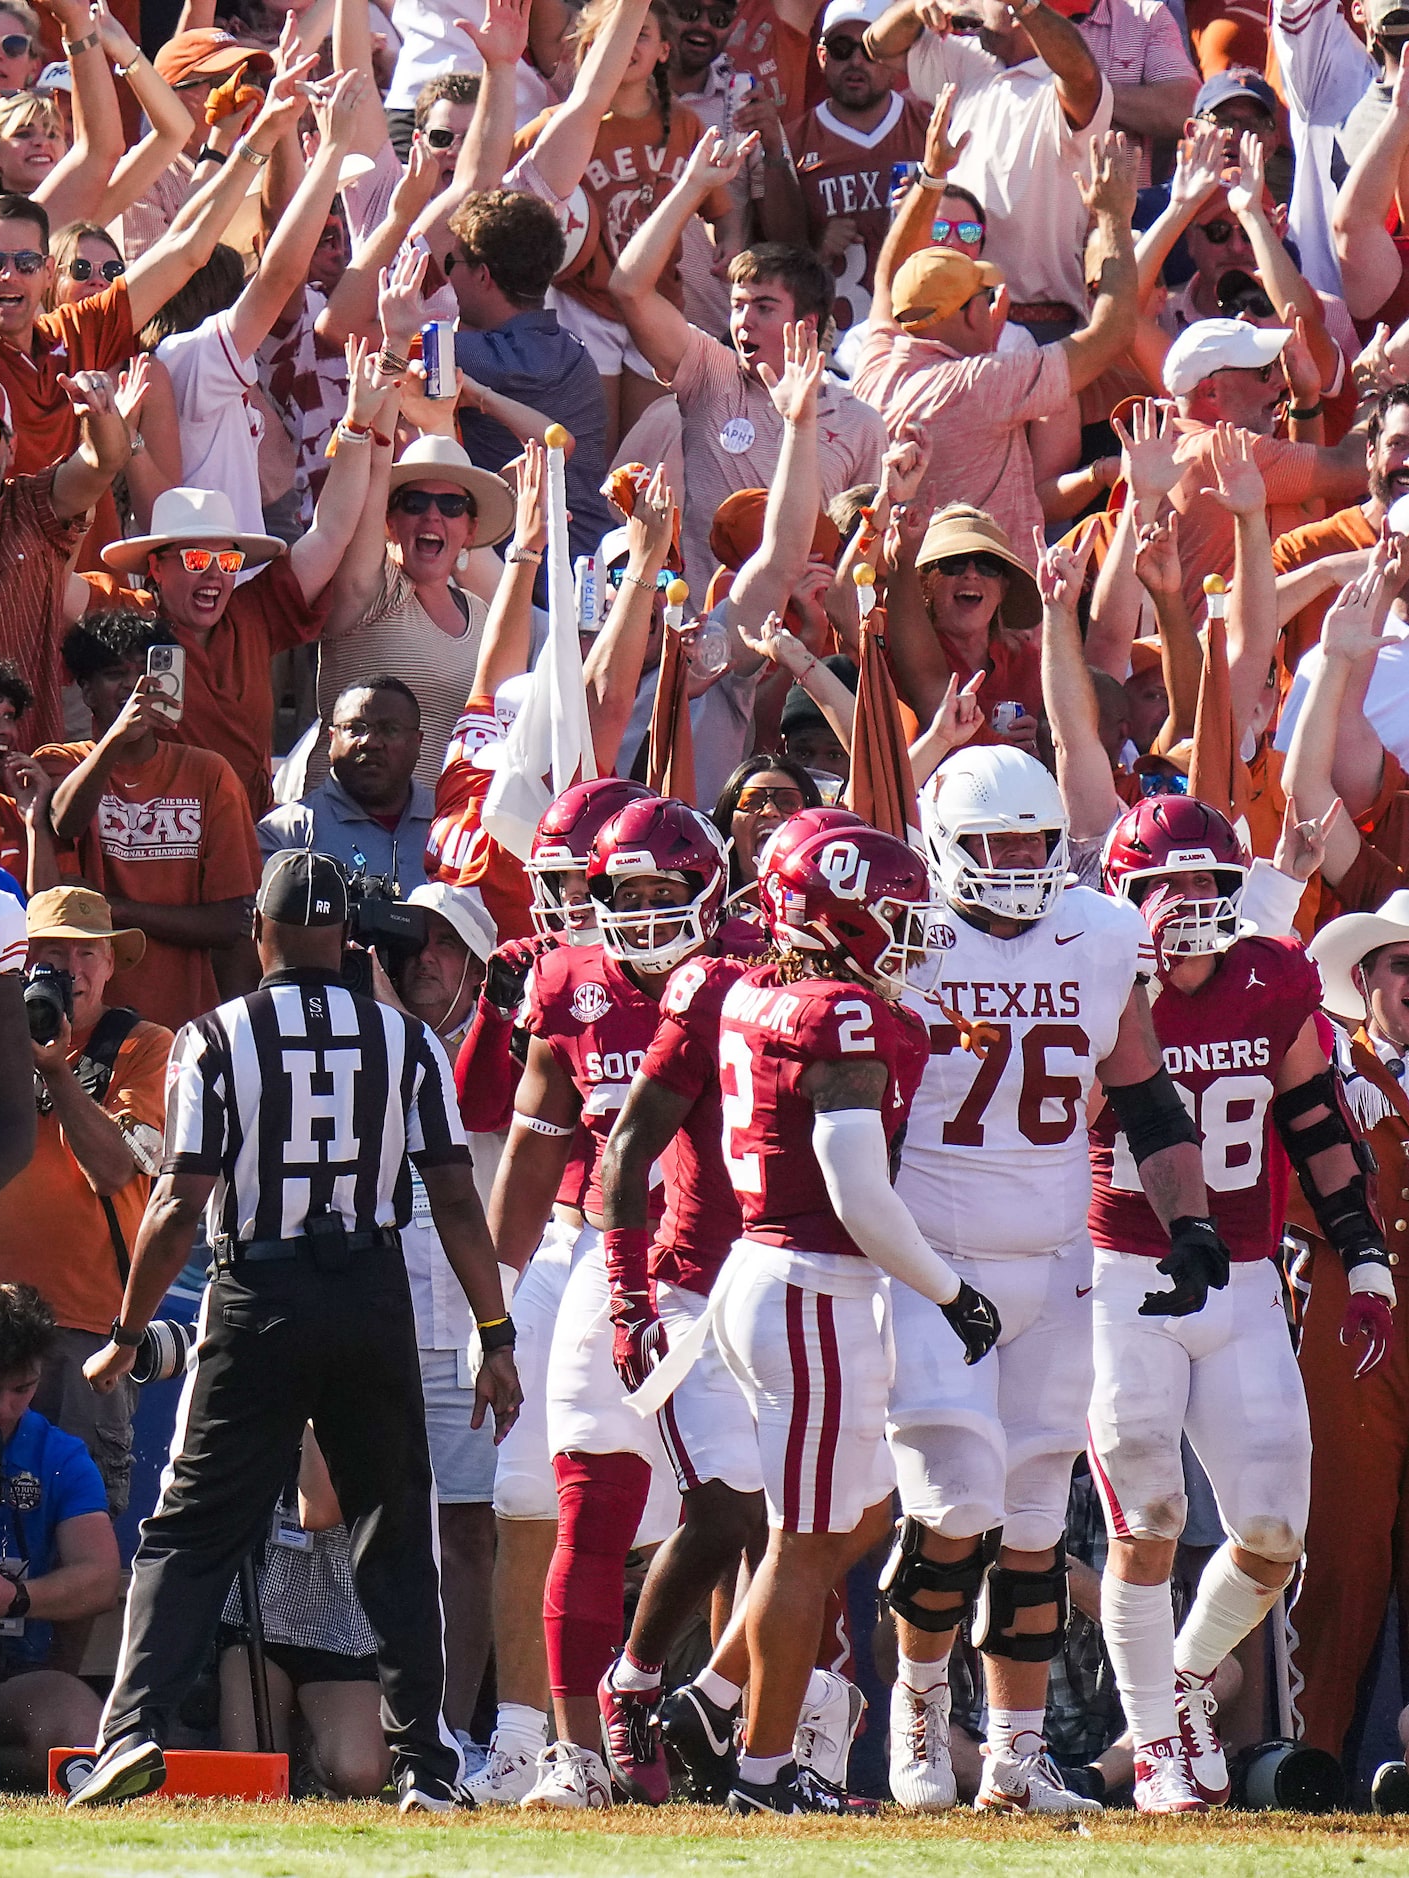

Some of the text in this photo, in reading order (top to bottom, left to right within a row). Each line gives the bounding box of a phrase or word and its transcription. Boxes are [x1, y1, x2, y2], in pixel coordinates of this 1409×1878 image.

[818, 170, 892, 216] TEX
[584, 576, 594, 622] ULTRA
[99, 802, 201, 847] EXAS
[819, 840, 870, 901] OU
[315, 899, 332, 915] RR
[576, 985, 604, 1011] SEC
[666, 964, 707, 1014] 8
[940, 981, 1080, 1018] TEXAS
[759, 992, 800, 1035] JR.
[834, 999, 875, 1052] 2
[585, 1050, 646, 1080] SOO
[1163, 1037, 1271, 1075] ONERS
[282, 1049, 362, 1164] H
[929, 1023, 1090, 1145] 76
